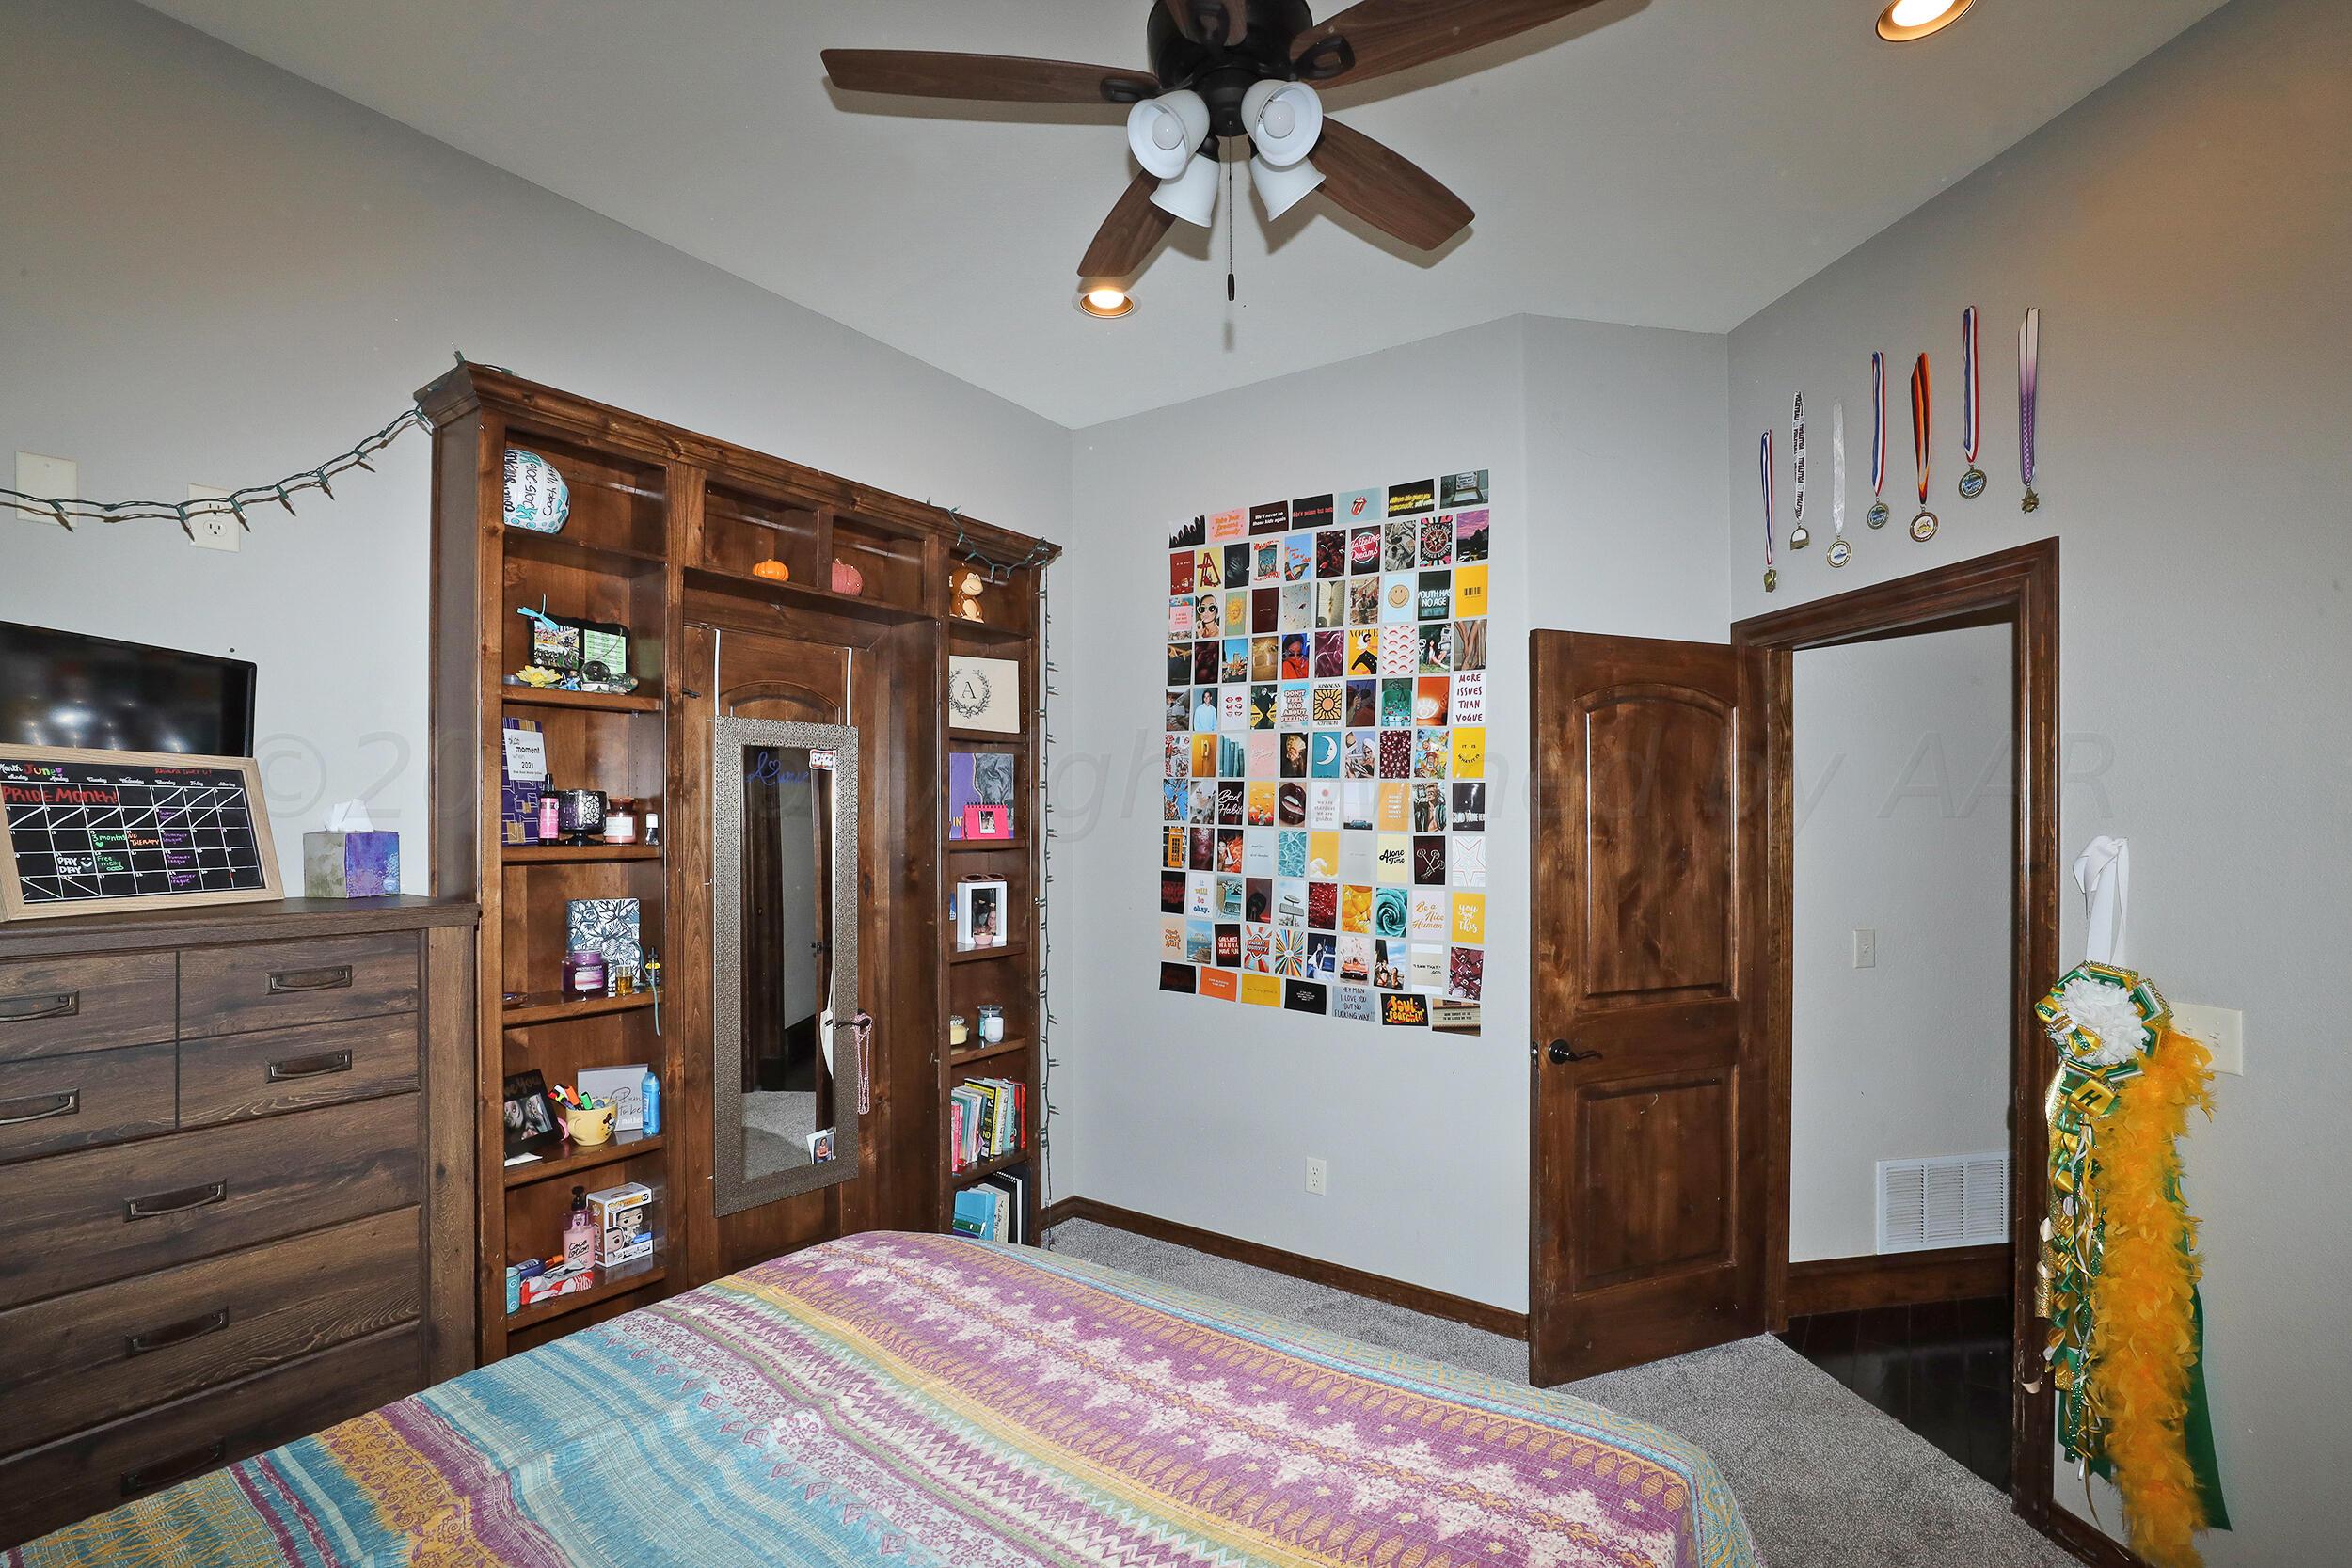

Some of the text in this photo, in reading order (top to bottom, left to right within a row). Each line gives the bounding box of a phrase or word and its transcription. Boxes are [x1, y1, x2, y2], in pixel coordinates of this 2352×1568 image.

[523, 462, 539, 509] 2015-2016
[542, 481, 557, 517] Coach
[1351, 533, 1381, 550] Caffeine
[1351, 546, 1378, 560] Dreams
[1418, 590, 1438, 599] YOUTH
[1433, 597, 1446, 606] AGE
[1459, 674, 1481, 682] MORE
[960, 681, 976, 699] A
[1457, 687, 1482, 696] ISSUES
[1459, 700, 1480, 709] THAN
[1456, 714, 1482, 723] VOGUE
[1458, 754, 1470, 763] WHAT
[24, 764, 57, 775] June
[2, 786, 54, 802] PRIDE
[1218, 790, 1242, 803] Bad
[1380, 849, 1404, 860] Alone
[57, 857, 77, 866] PAY
[1389, 857, 1404, 865] Time
[1193, 905, 1210, 914] okay.
[1416, 902, 1428, 911] Be
[1459, 904, 1478, 915] you
[1426, 911, 1445, 922] Nice
[1412, 919, 1443, 929] Human
[1460, 919, 1478, 934] this
[1389, 996, 1416, 1012] Soul
[2077, 1089, 2102, 1107] H
[569, 1240, 587, 1250] Coco
